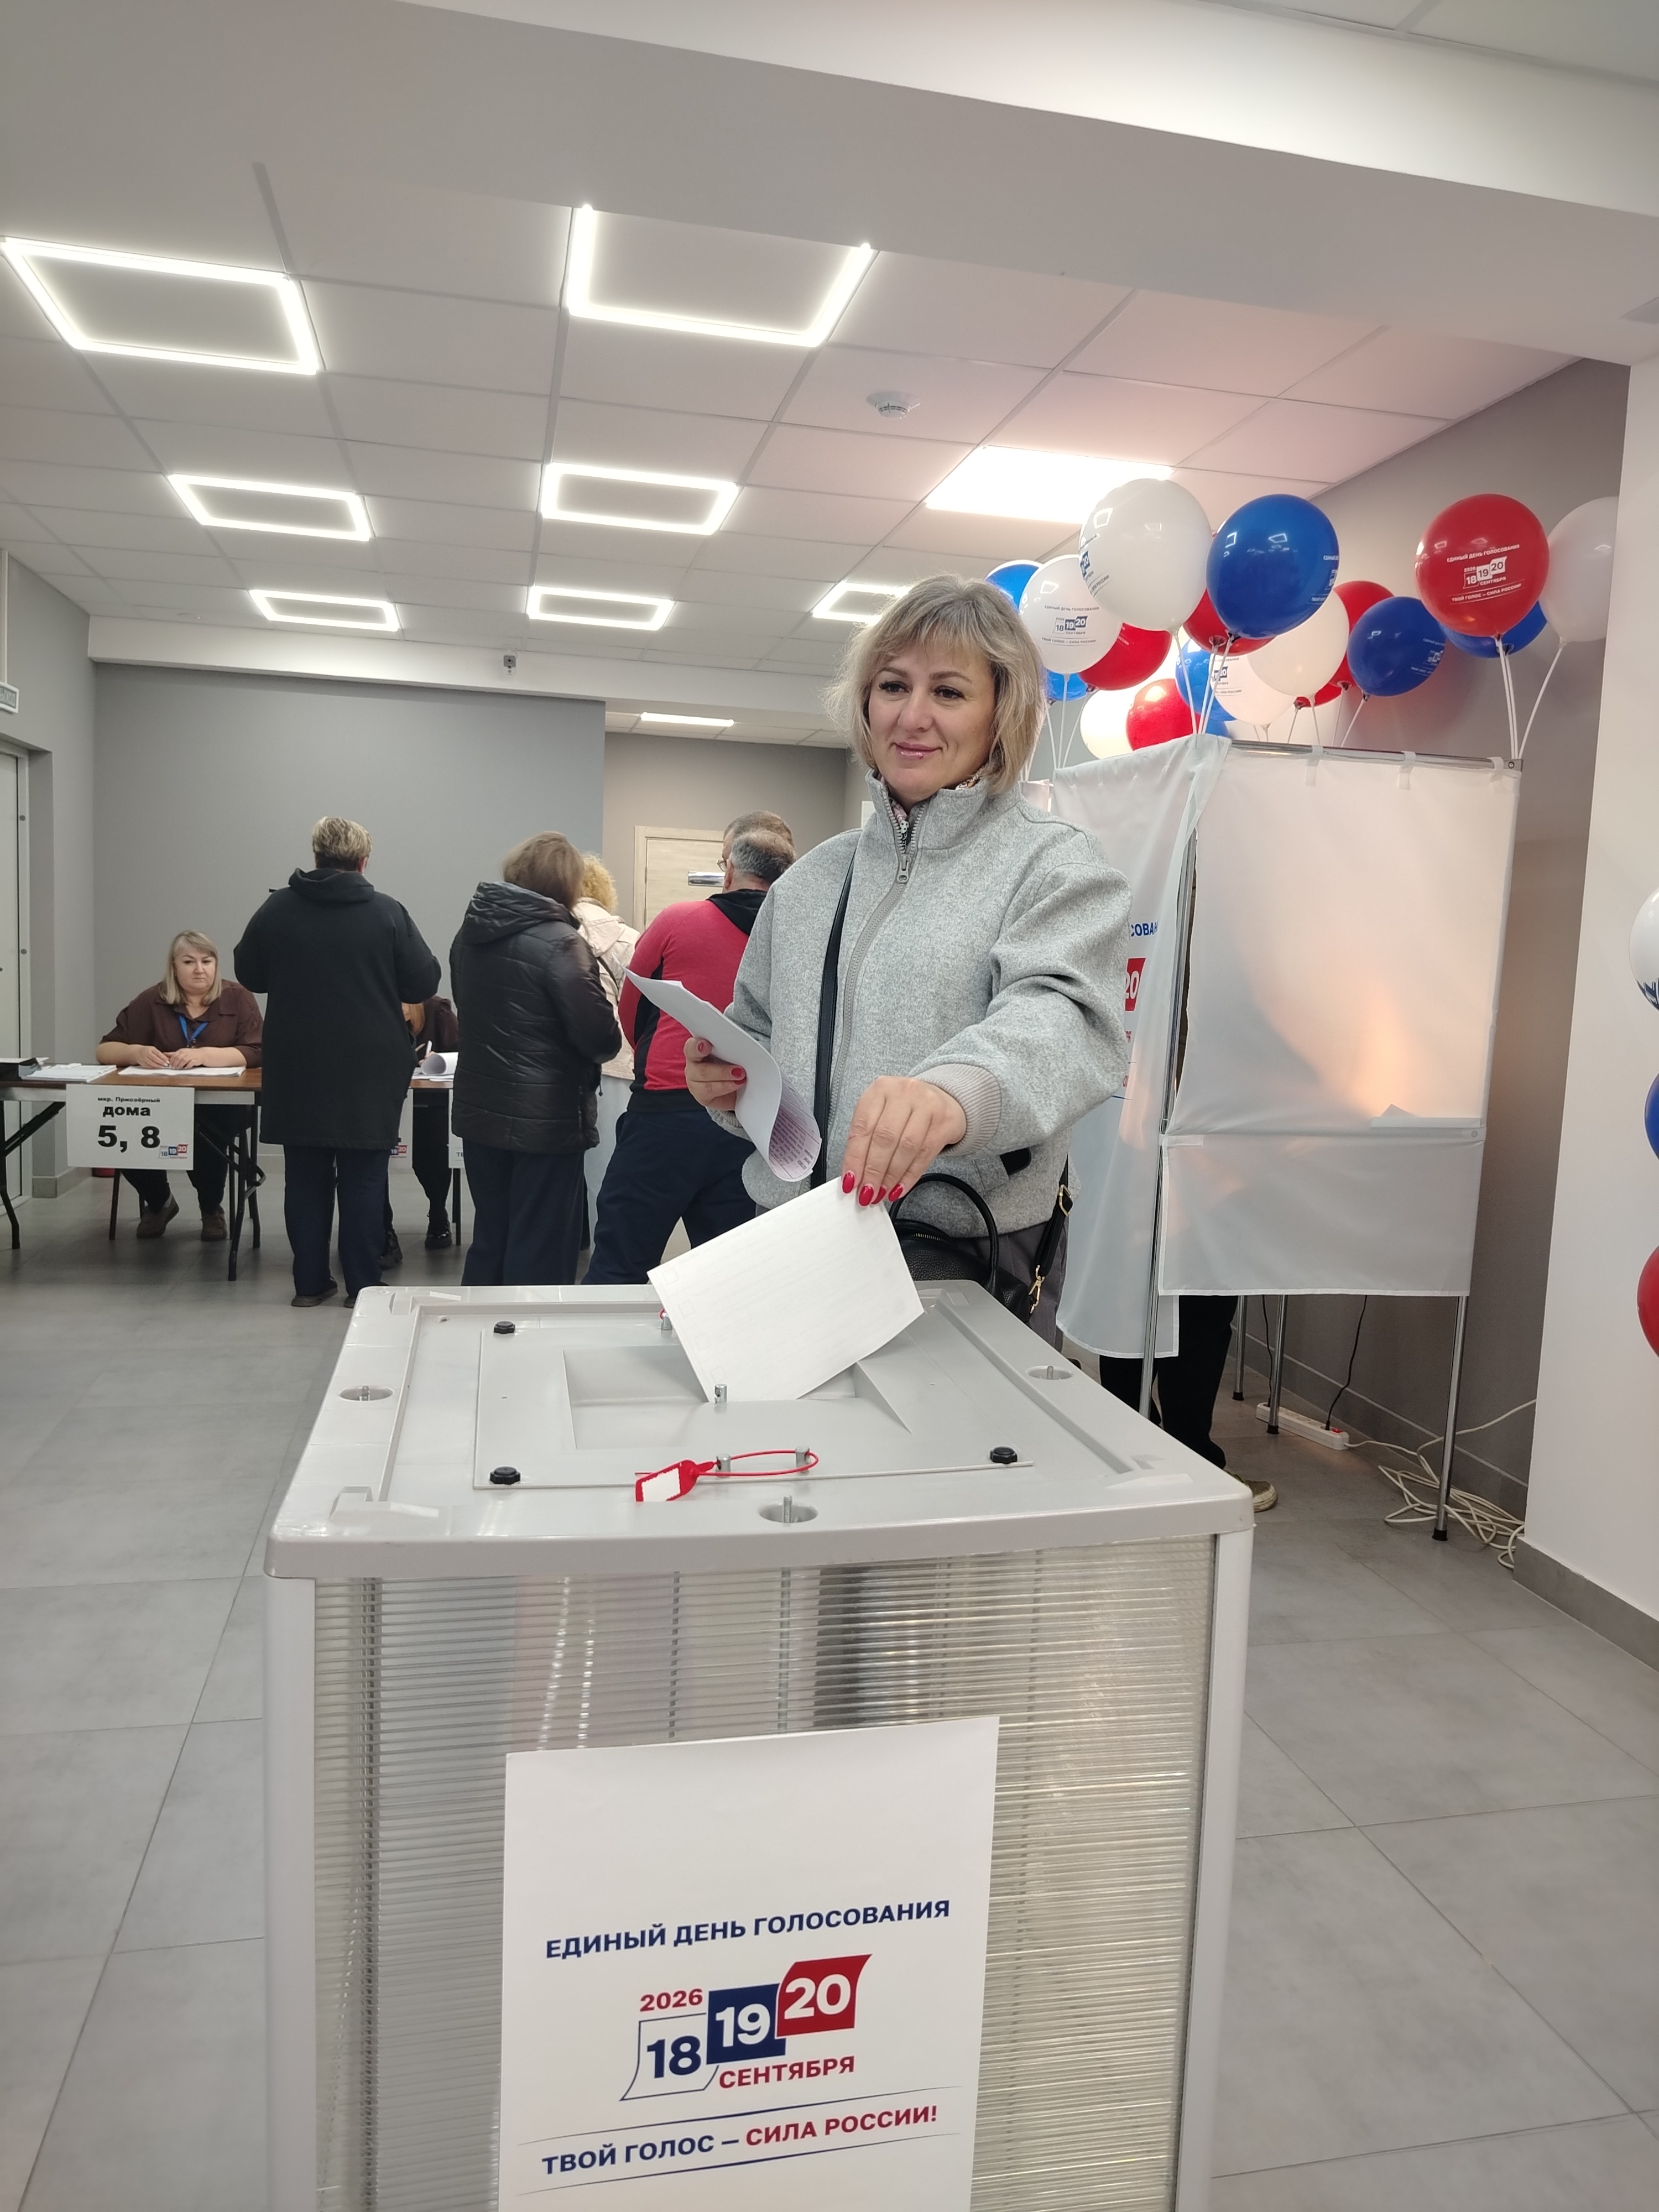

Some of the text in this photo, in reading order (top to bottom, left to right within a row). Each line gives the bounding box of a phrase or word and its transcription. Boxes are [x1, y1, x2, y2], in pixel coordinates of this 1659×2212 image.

[1447, 554, 1468, 562] ЕДИНЫЙ
[1484, 544, 1520, 556] ГОЛОСОВАНИЯ
[1466, 561, 1504, 585] 18 19 20
[1480, 577, 1506, 586] СЕНТЯБРЯ
[102, 1106, 150, 1118] дома
[97, 1125, 160, 1153] 5, 8
[546, 1899, 950, 1959] ЕДИНЫЙ ДЕНЬ ГОЛОСОВАНИЯ
[640, 1989, 703, 2012] 2026
[646, 1974, 851, 2079] 18 19 20
[718, 2056, 855, 2089] СЕНТЯБРЯ
[542, 2142, 617, 2176] ТВОЙ
[624, 2135, 714, 2163] ГОЛОС
[745, 2120, 817, 2147] СИЛА
[825, 2104, 938, 2136] РОССИИ!
